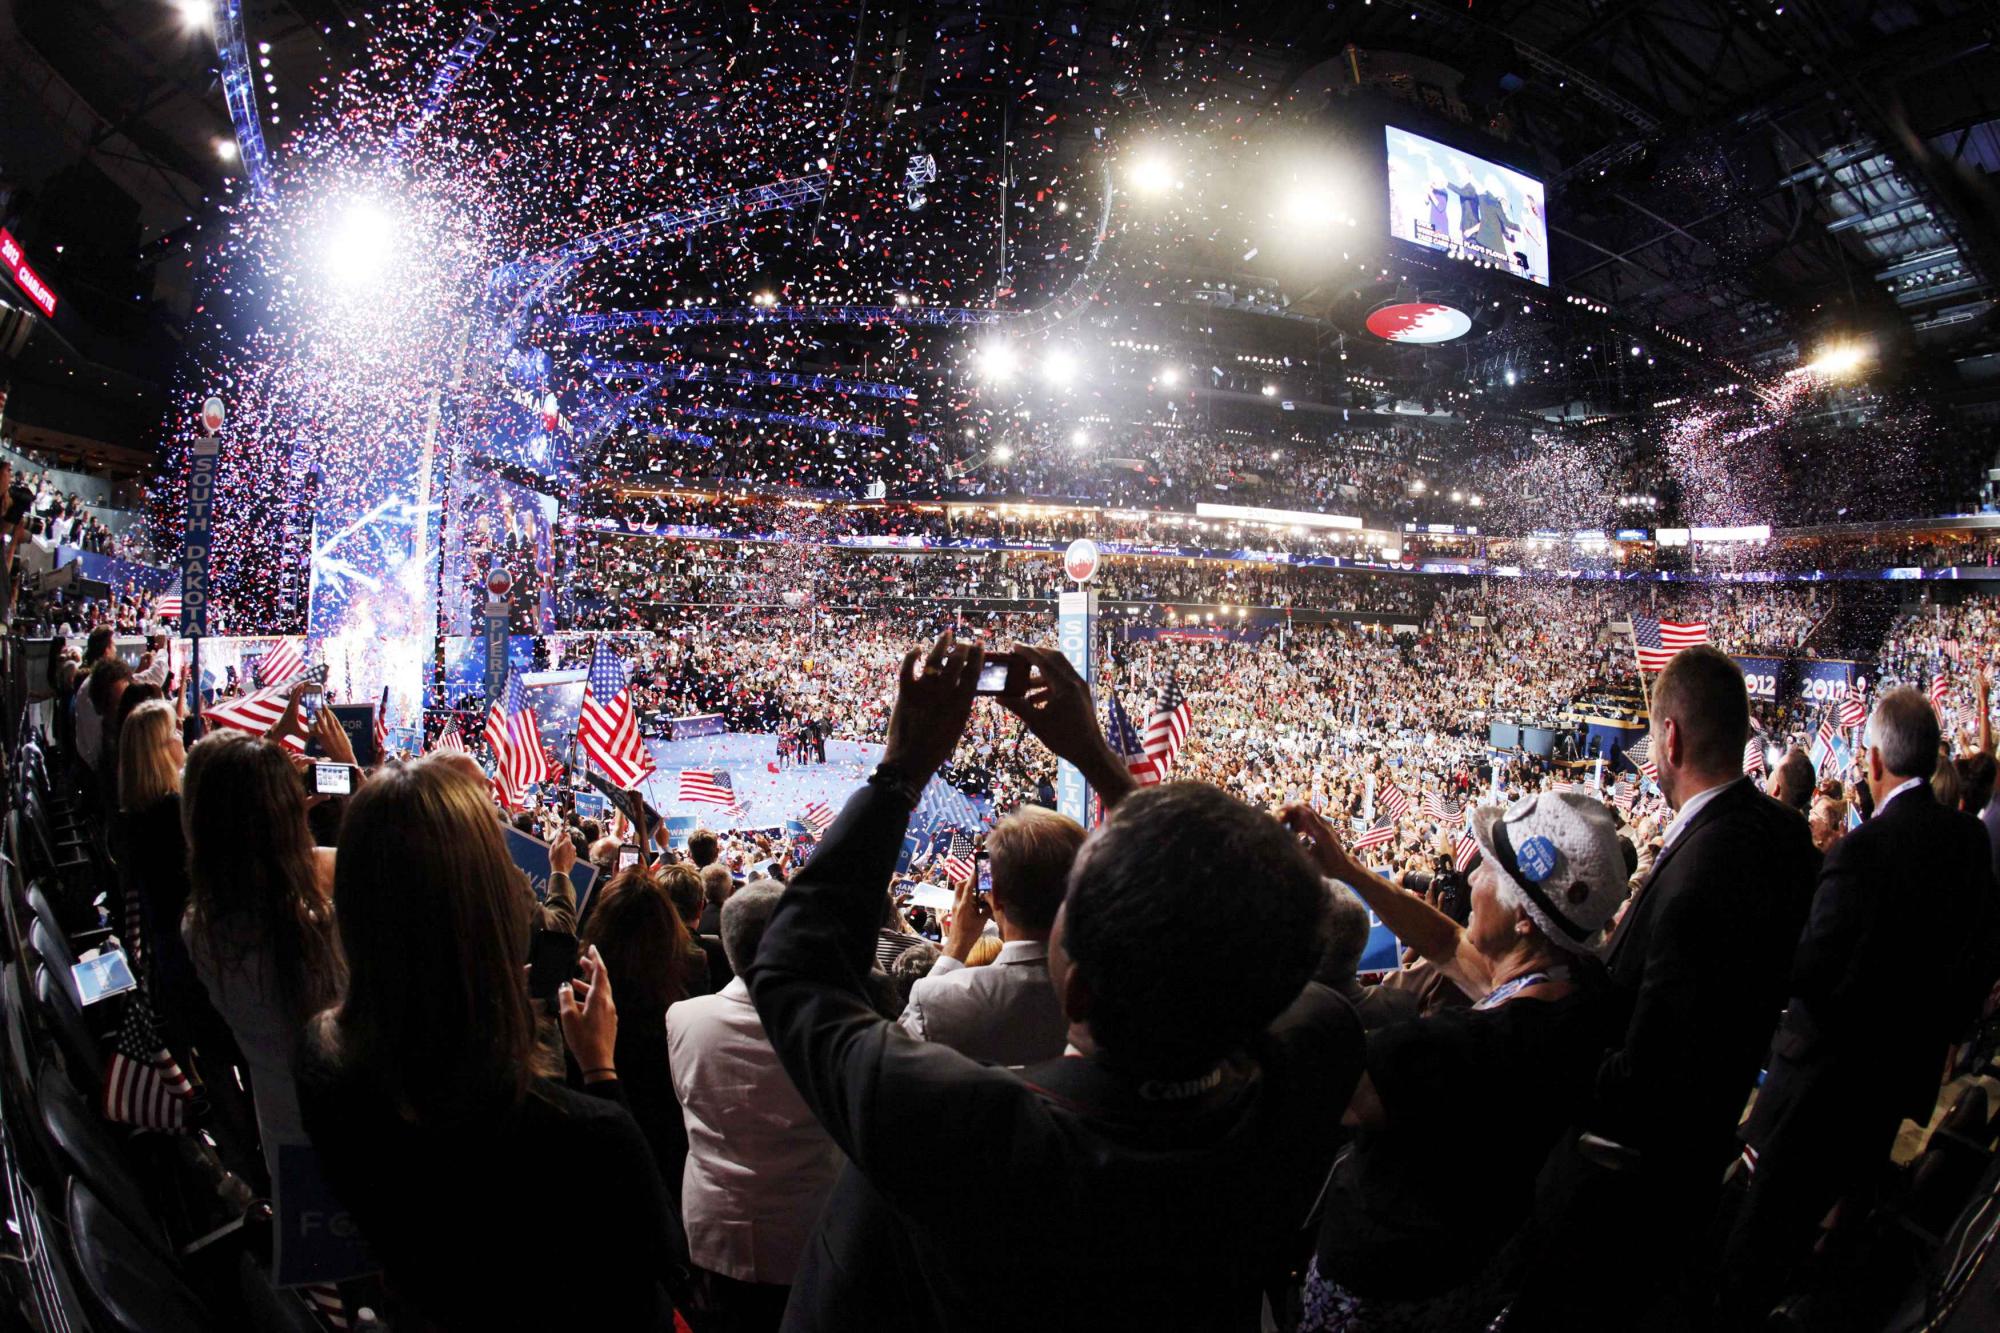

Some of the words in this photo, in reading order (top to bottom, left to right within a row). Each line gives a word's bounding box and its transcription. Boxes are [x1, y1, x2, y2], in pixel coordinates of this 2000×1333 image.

[19, 266, 56, 312] CHARLOTTE
[188, 458, 213, 532] SOUTH
[184, 545, 206, 636] DAKOTA
[1089, 620, 1098, 697] SOUTH
[1522, 842, 1537, 860] IS
[1531, 857, 1548, 877] IN
[1138, 1068, 1221, 1101] Canon
